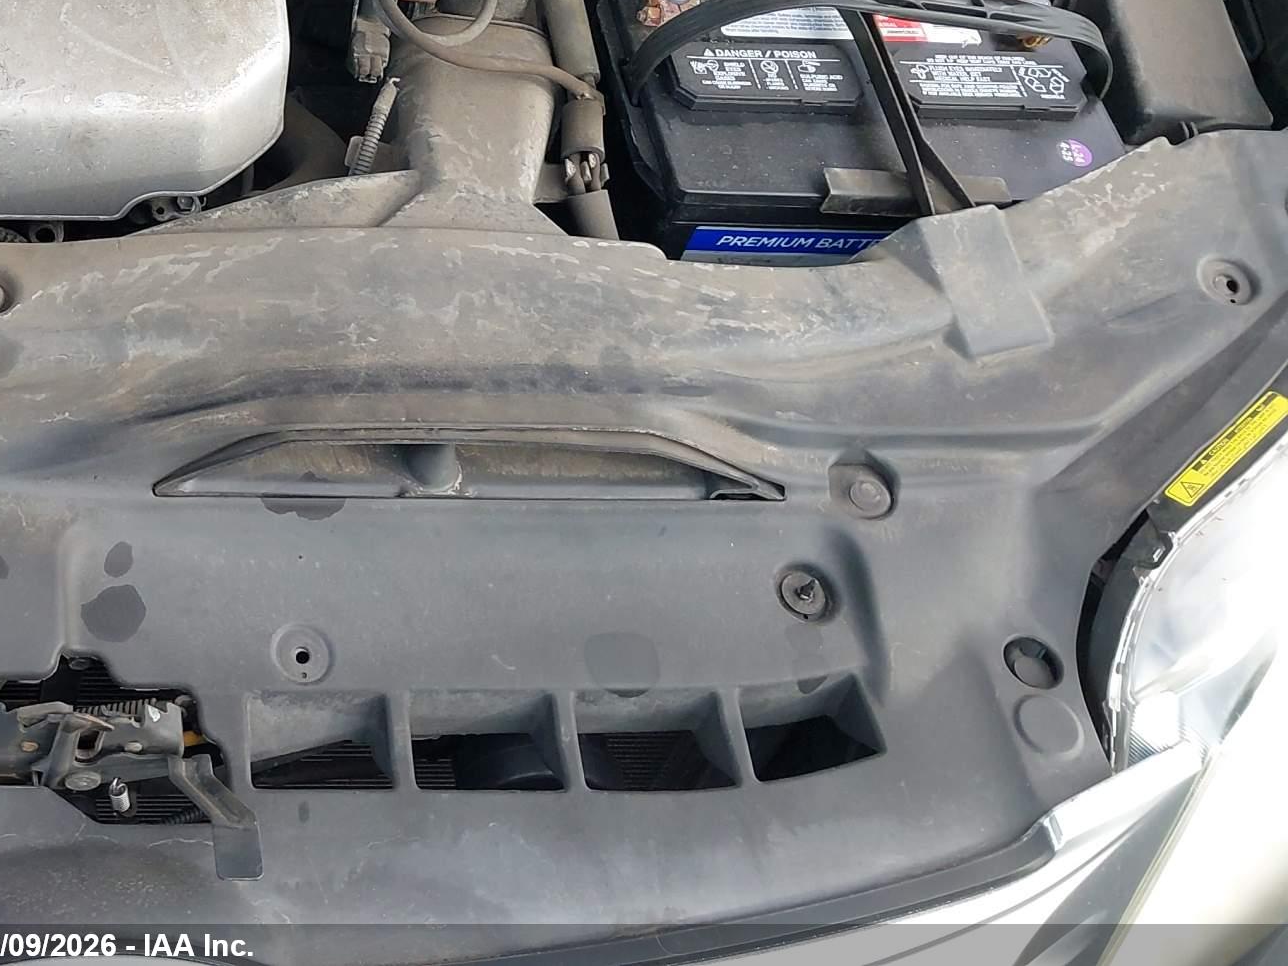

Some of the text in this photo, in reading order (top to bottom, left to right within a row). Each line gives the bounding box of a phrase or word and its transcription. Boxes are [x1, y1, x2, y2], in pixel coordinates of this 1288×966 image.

[714, 49, 763, 58] DANGER
[773, 50, 817, 59] POISON
[716, 235, 815, 248] PREMIUM
